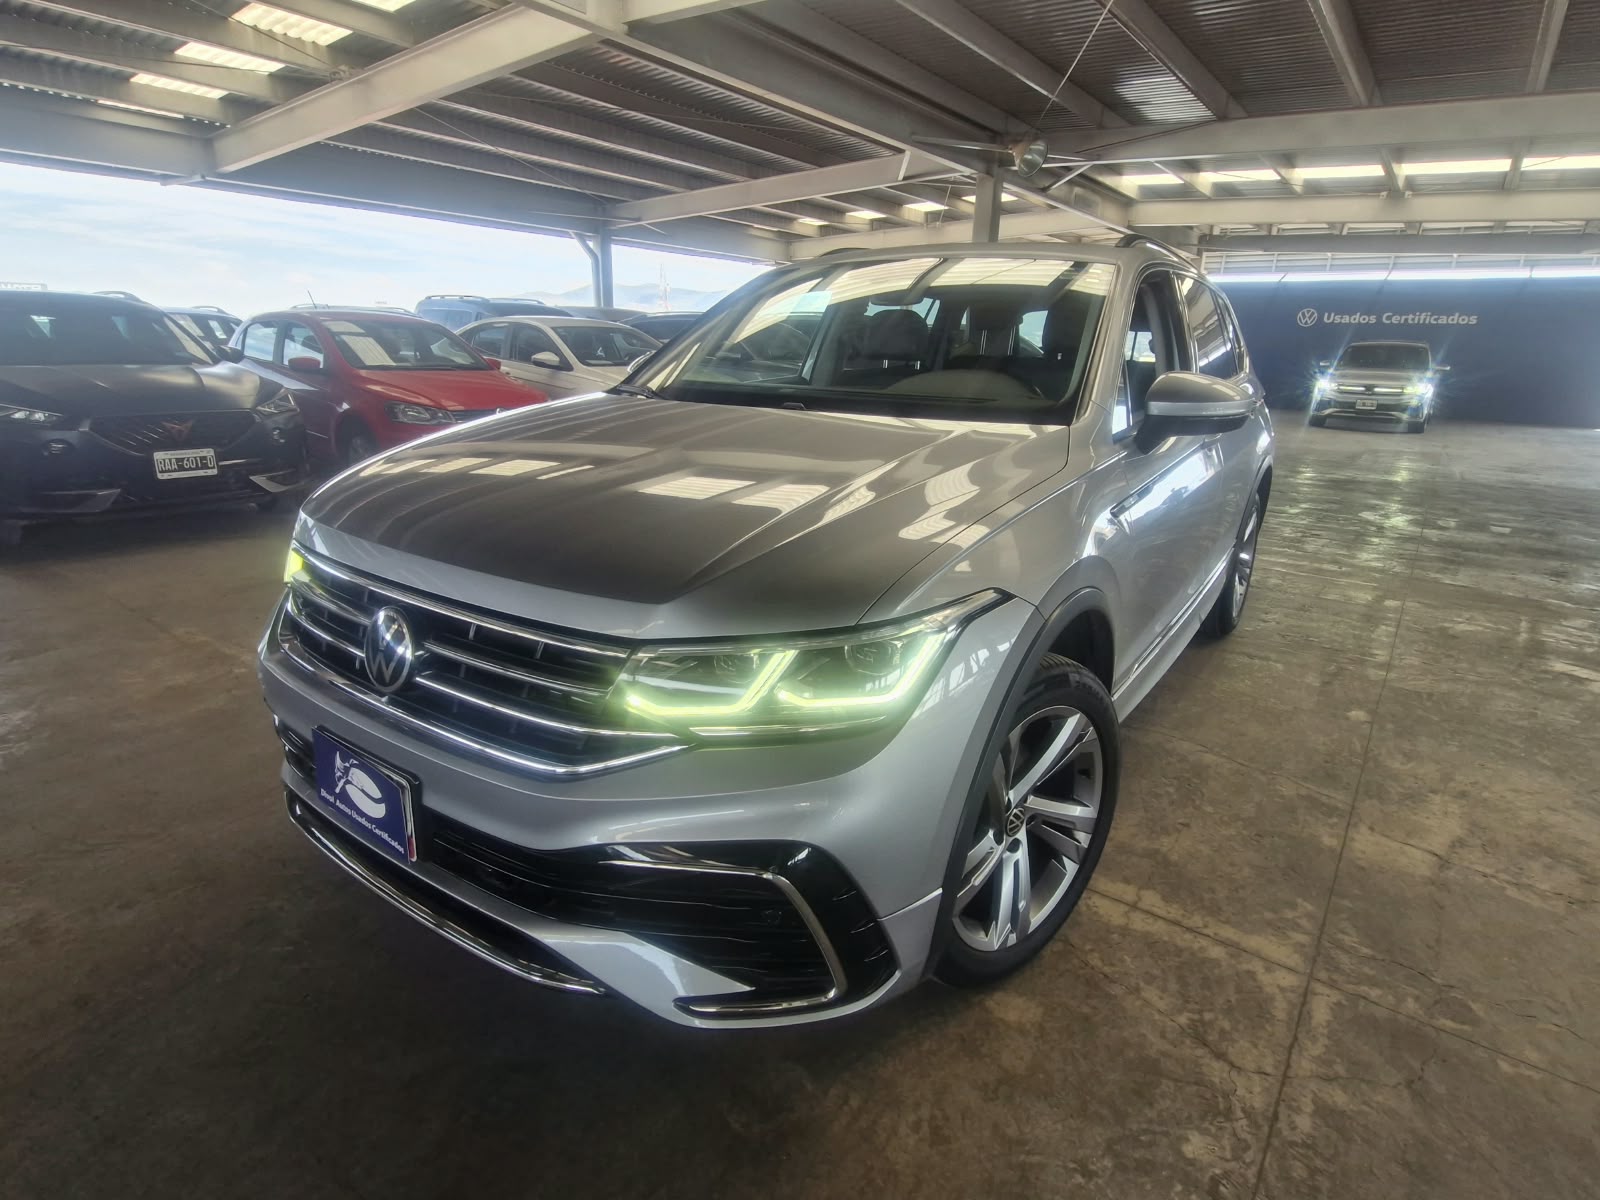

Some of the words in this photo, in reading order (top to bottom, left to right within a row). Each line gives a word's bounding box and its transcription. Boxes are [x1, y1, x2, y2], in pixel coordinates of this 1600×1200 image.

[1323, 312, 1377, 324] Usados
[1382, 312, 1478, 325] Certificados
[335, 799, 352, 815] Autos
[351, 810, 372, 829] Usados
[371, 824, 405, 854] Certificados
